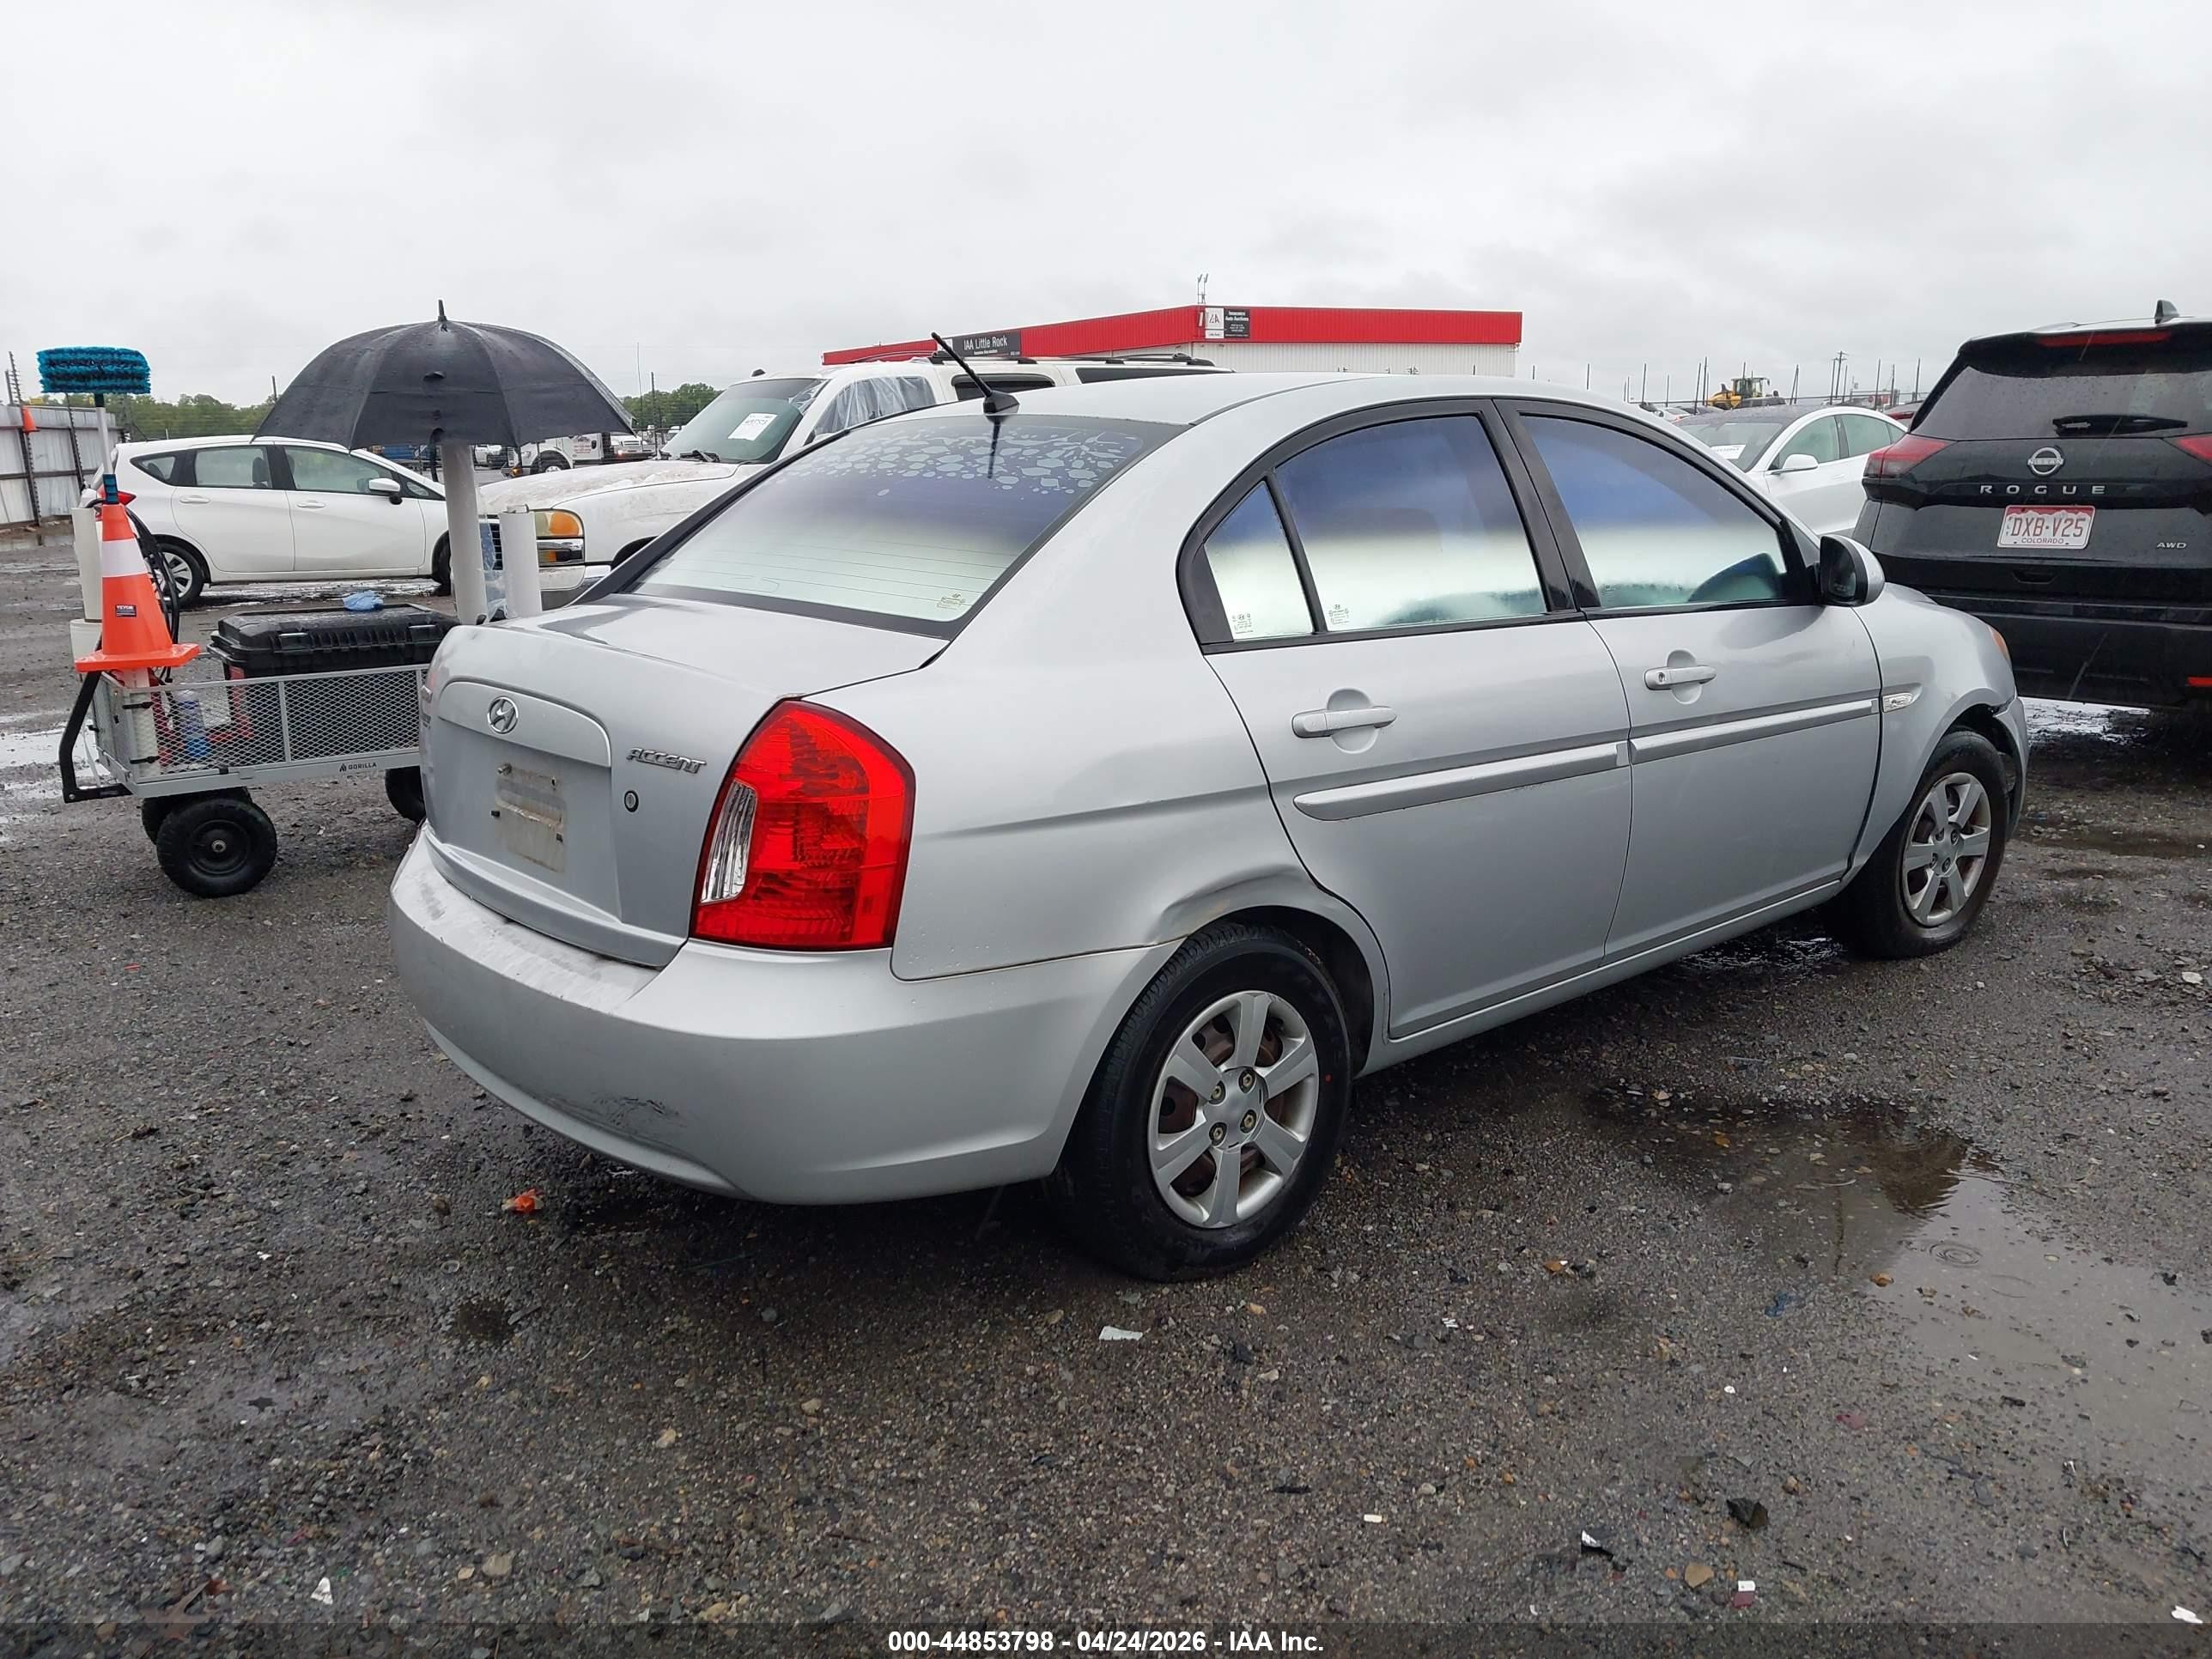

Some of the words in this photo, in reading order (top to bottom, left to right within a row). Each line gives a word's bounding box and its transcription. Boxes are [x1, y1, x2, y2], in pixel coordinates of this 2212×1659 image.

[963, 338, 974, 350] IAA
[975, 337, 990, 349] Little
[992, 334, 1008, 348] Rock
[2027, 457, 2064, 465] NISSAN
[1979, 484, 2106, 495] ROGUE
[348, 762, 377, 770] GORILLA
[626, 747, 707, 774] ACCENT
